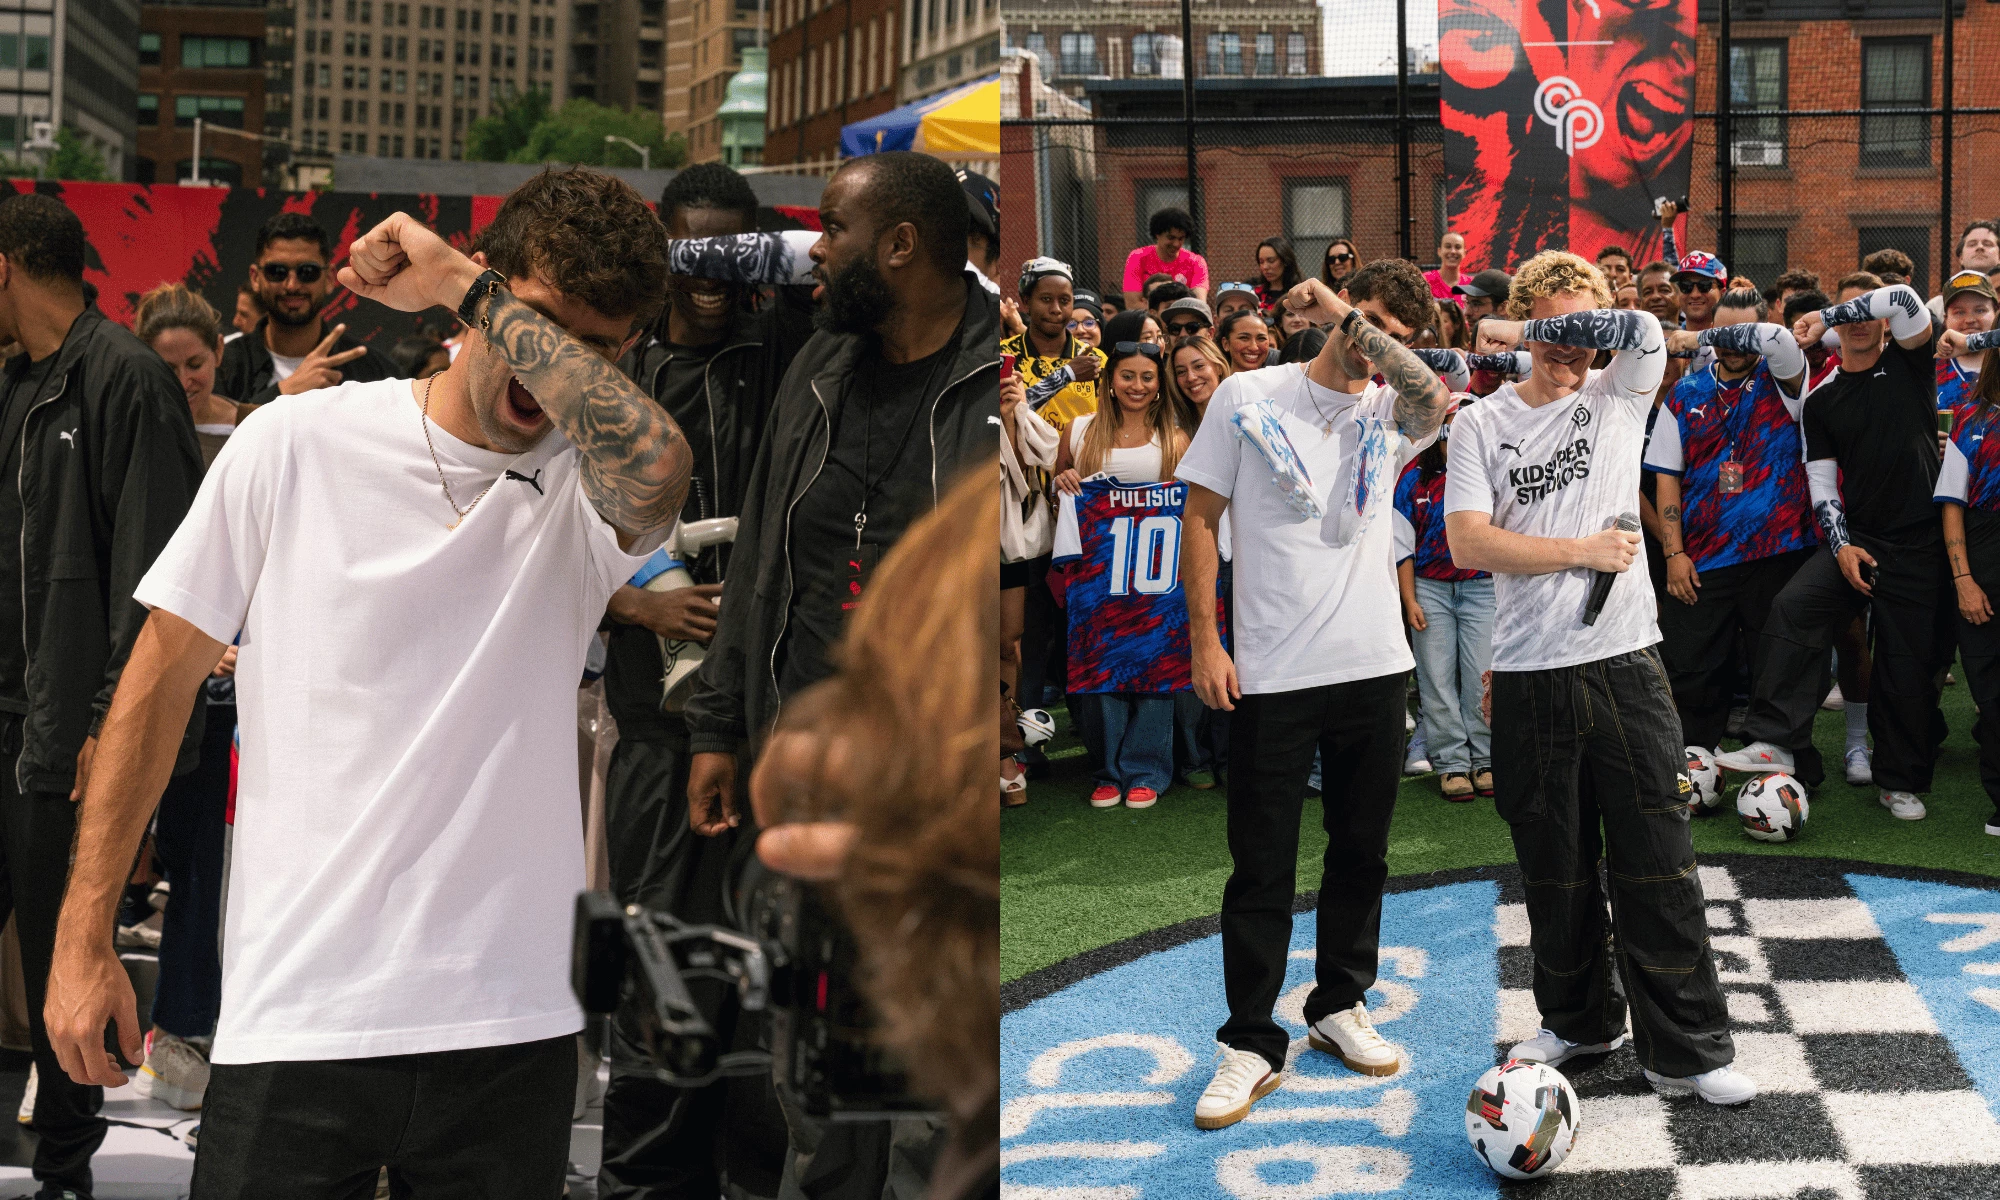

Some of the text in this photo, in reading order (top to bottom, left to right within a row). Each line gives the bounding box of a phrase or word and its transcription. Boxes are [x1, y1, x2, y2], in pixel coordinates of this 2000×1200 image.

[1681, 255, 1710, 271] USA
[1889, 290, 1920, 319] PUMA
[1109, 486, 1182, 508] PULISIC
[1109, 515, 1183, 596] 10
